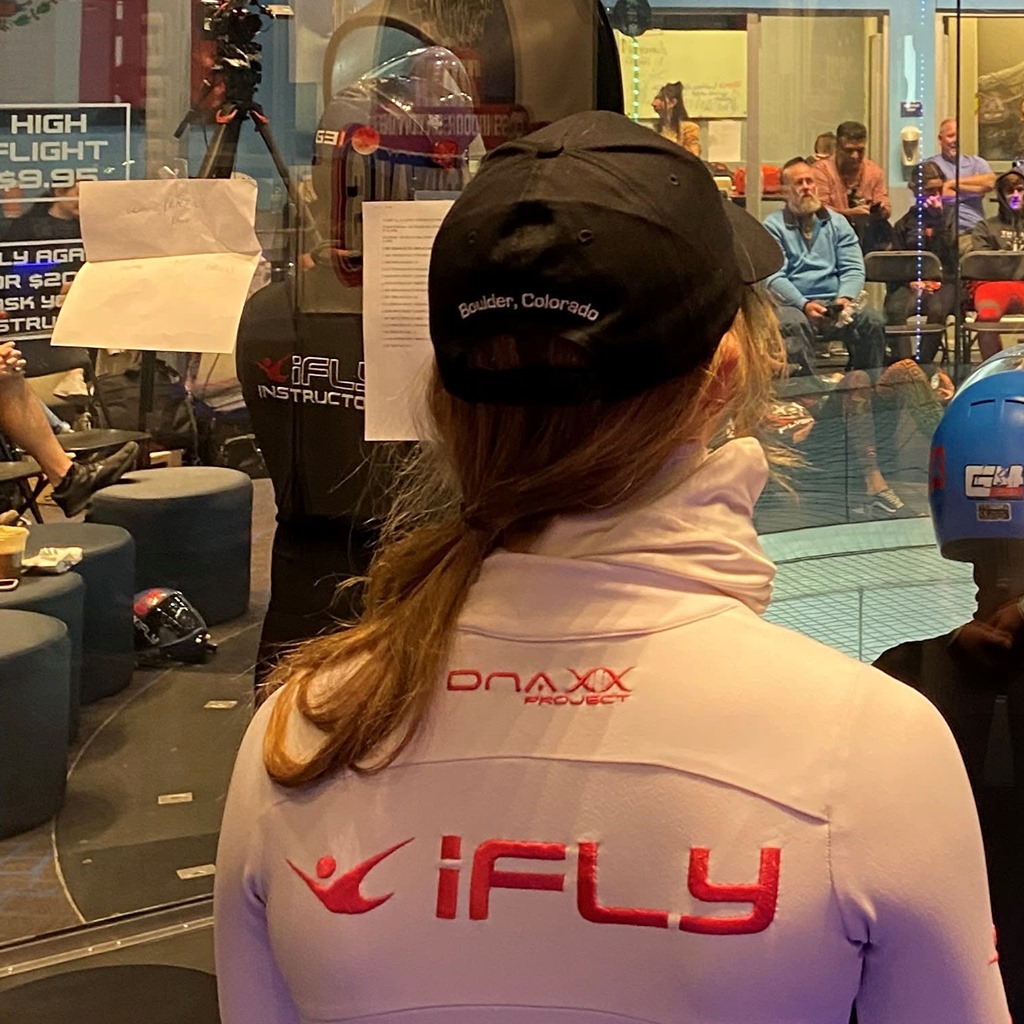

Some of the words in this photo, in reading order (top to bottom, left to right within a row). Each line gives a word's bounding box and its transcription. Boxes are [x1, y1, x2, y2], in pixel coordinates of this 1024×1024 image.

[11, 114, 87, 134] HIGH
[0, 168, 98, 191] $9.95
[0, 274, 21, 289] R
[0, 296, 35, 311] SK
[458, 293, 518, 319] Boulder,
[521, 293, 599, 321] Colorado
[524, 695, 632, 706] PROJECT
